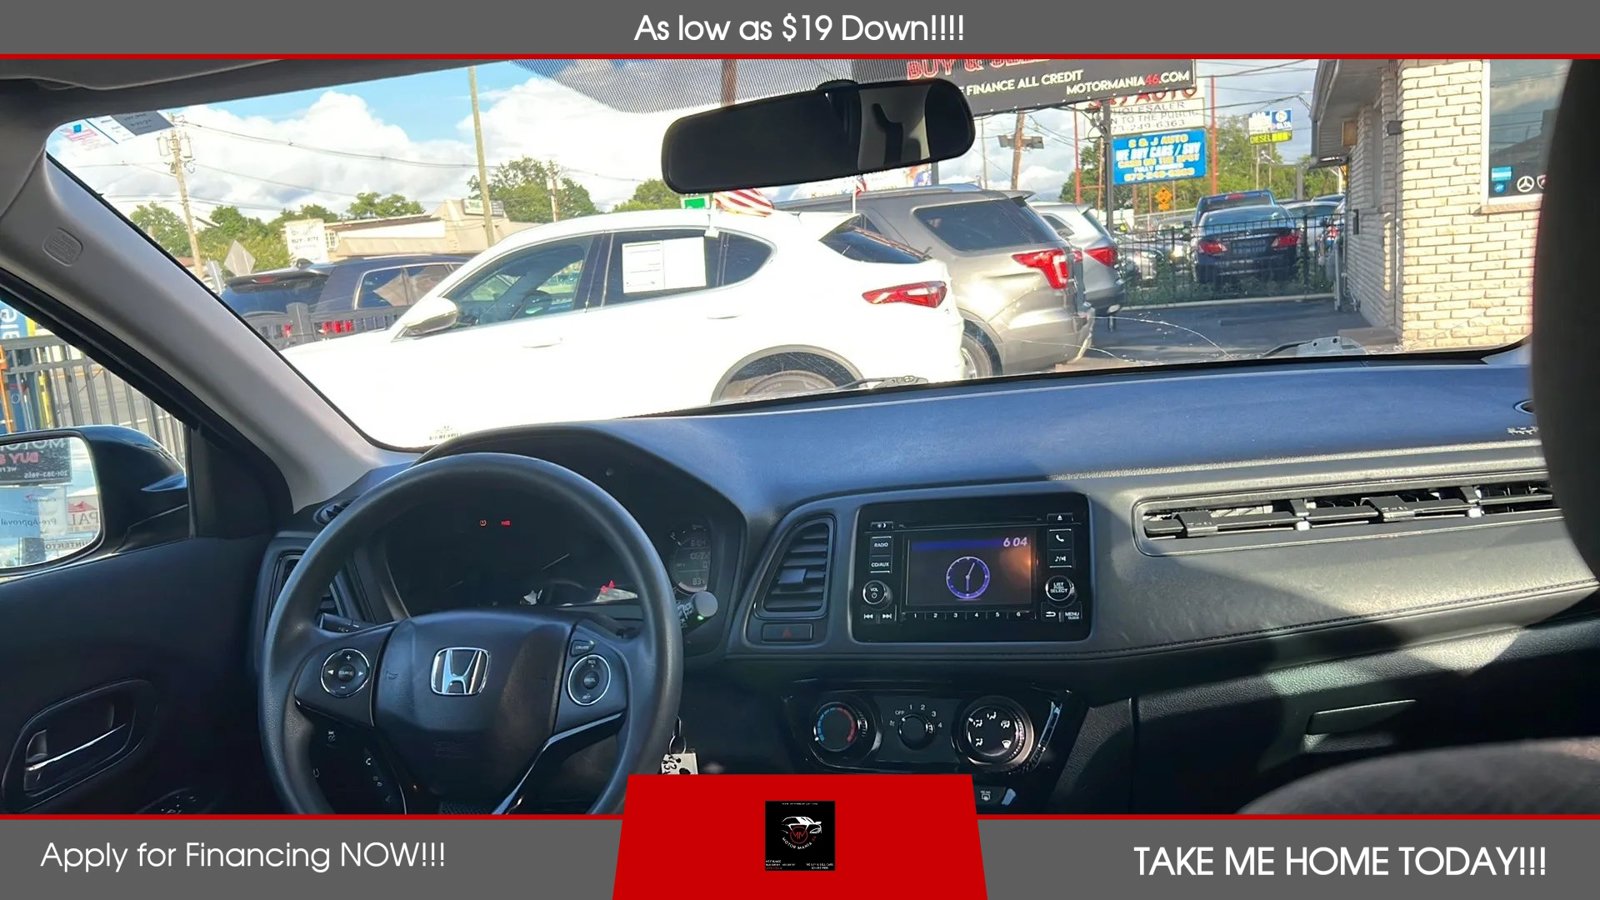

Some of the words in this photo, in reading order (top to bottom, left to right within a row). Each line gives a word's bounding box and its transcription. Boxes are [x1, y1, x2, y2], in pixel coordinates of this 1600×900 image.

[906, 59, 956, 81] BUY
[966, 79, 1016, 96] FINANCE
[1017, 76, 1040, 90] ALL
[1041, 69, 1084, 86] CREDIT
[1066, 70, 1190, 96] MOTORMANIA46.COM
